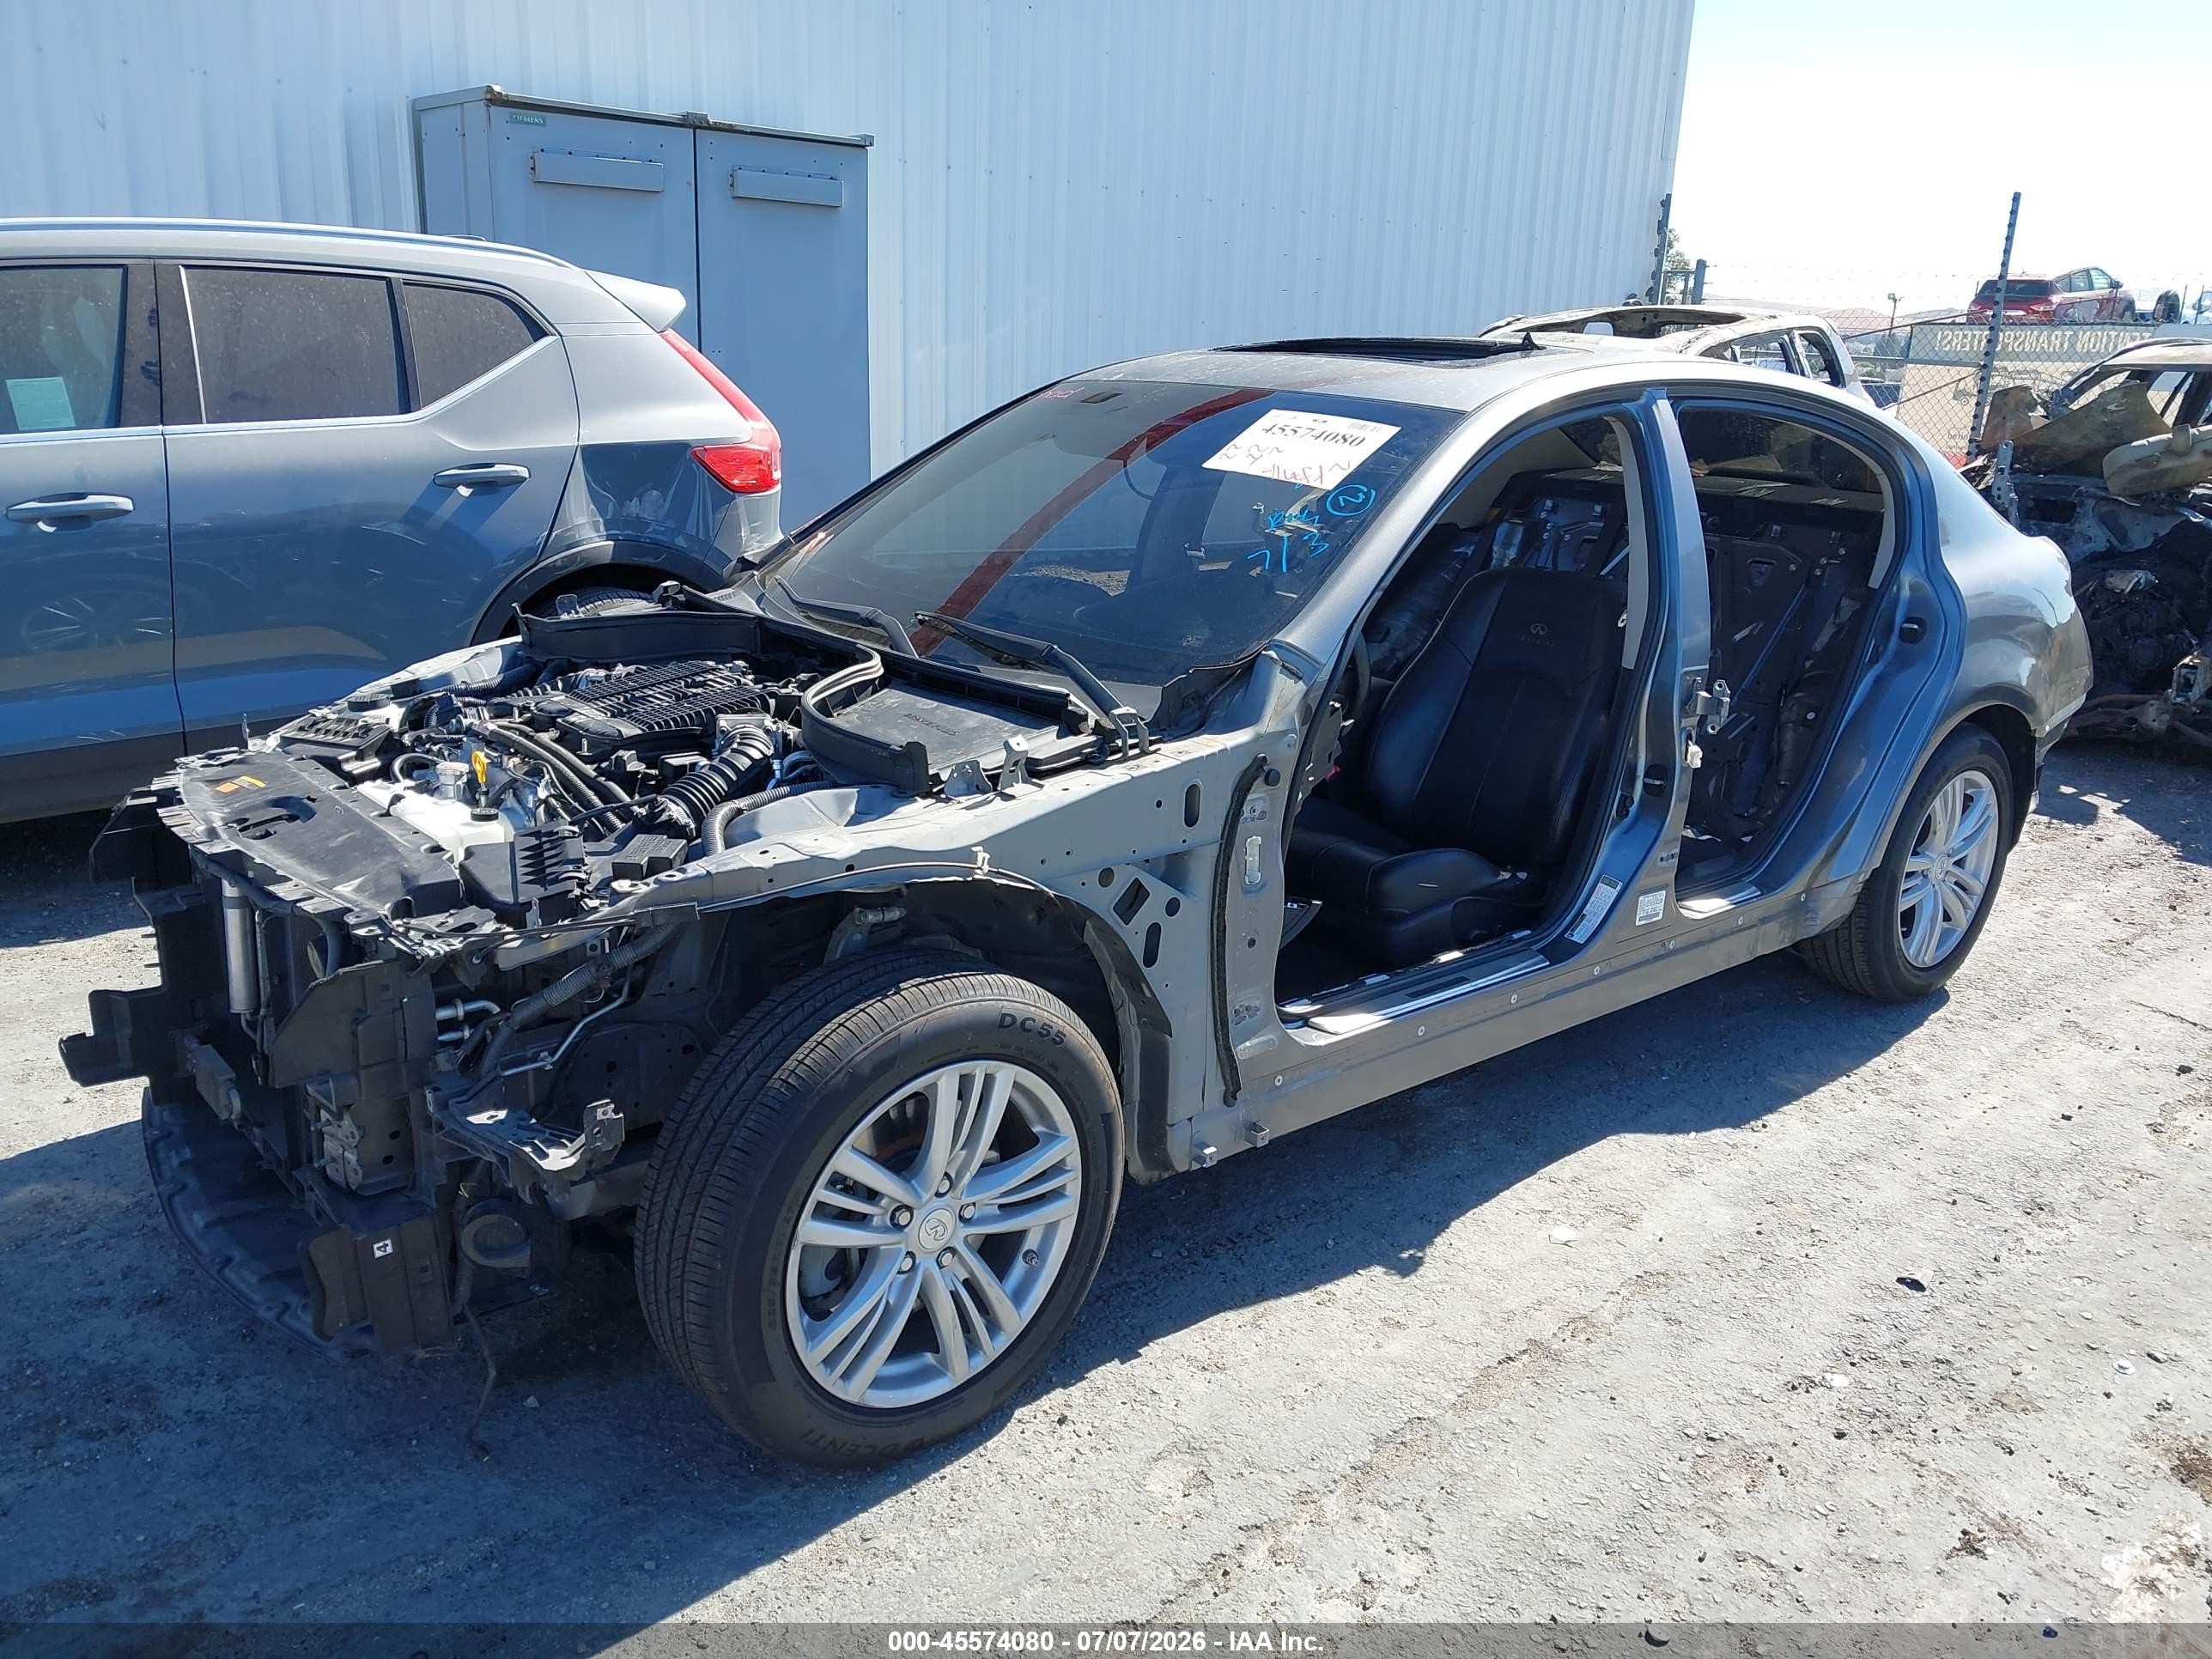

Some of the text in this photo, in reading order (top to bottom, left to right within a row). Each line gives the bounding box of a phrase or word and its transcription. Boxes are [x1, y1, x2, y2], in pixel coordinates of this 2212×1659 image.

[1261, 423, 1366, 447] 45574080
[997, 1013, 1066, 1046] DC55
[376, 1243, 389, 1253] 4
